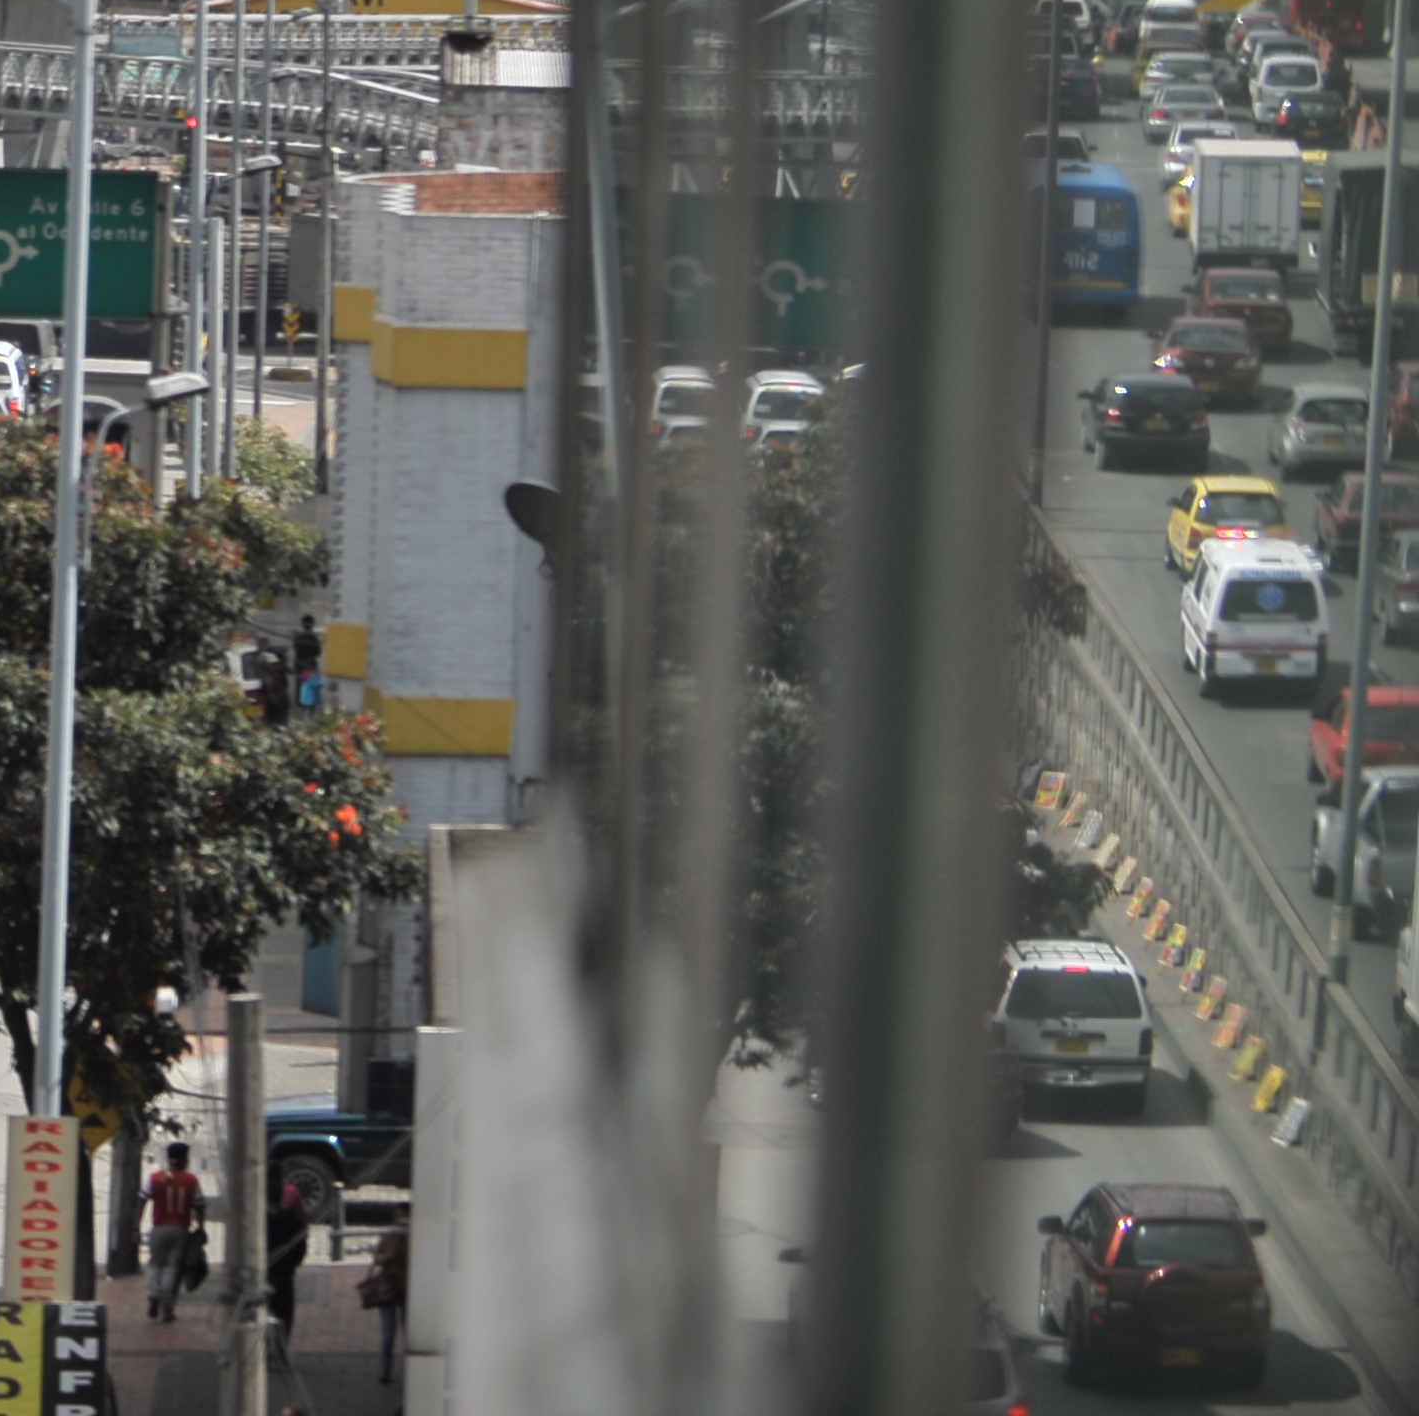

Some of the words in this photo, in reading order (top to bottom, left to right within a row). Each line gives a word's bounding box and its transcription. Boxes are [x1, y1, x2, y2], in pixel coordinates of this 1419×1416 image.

[29, 197, 58, 215] Av
[130, 199, 145, 216] 6
[16, 225, 37, 240] al
